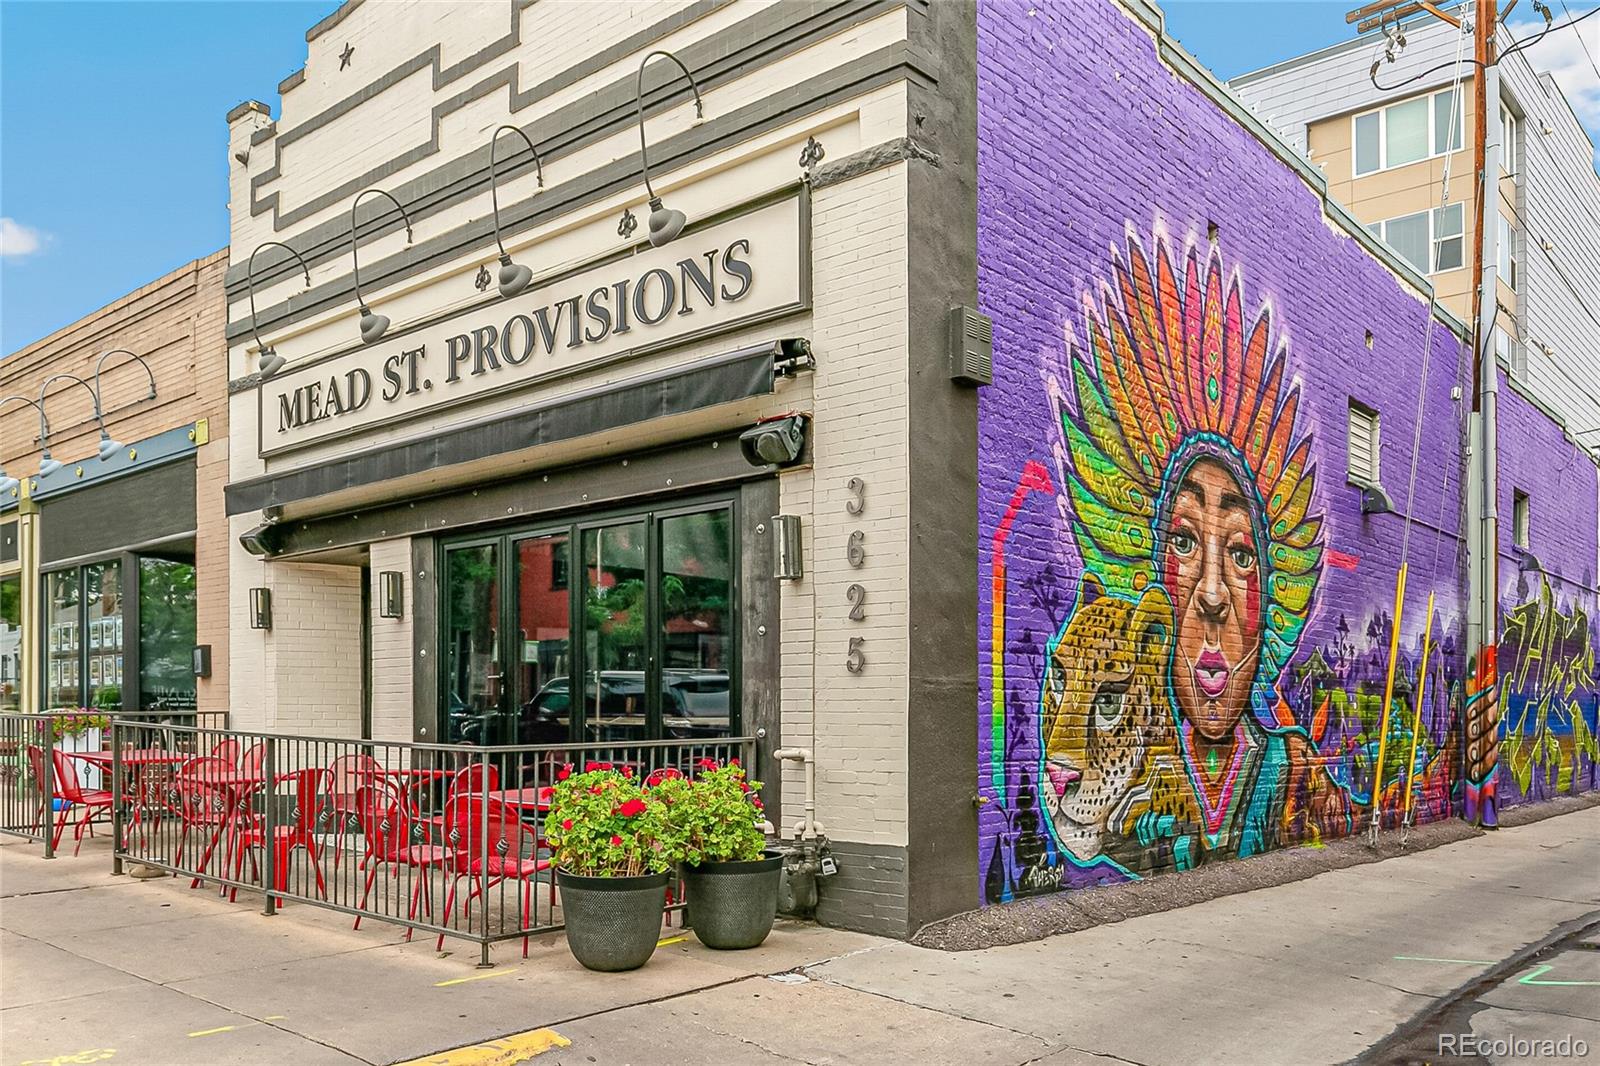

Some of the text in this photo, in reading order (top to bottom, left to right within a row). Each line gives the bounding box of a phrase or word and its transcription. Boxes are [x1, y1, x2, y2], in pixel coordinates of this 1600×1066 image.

[277, 239, 753, 432] MEAD ST. PROVISIONS
[846, 477, 865, 675] 3625
